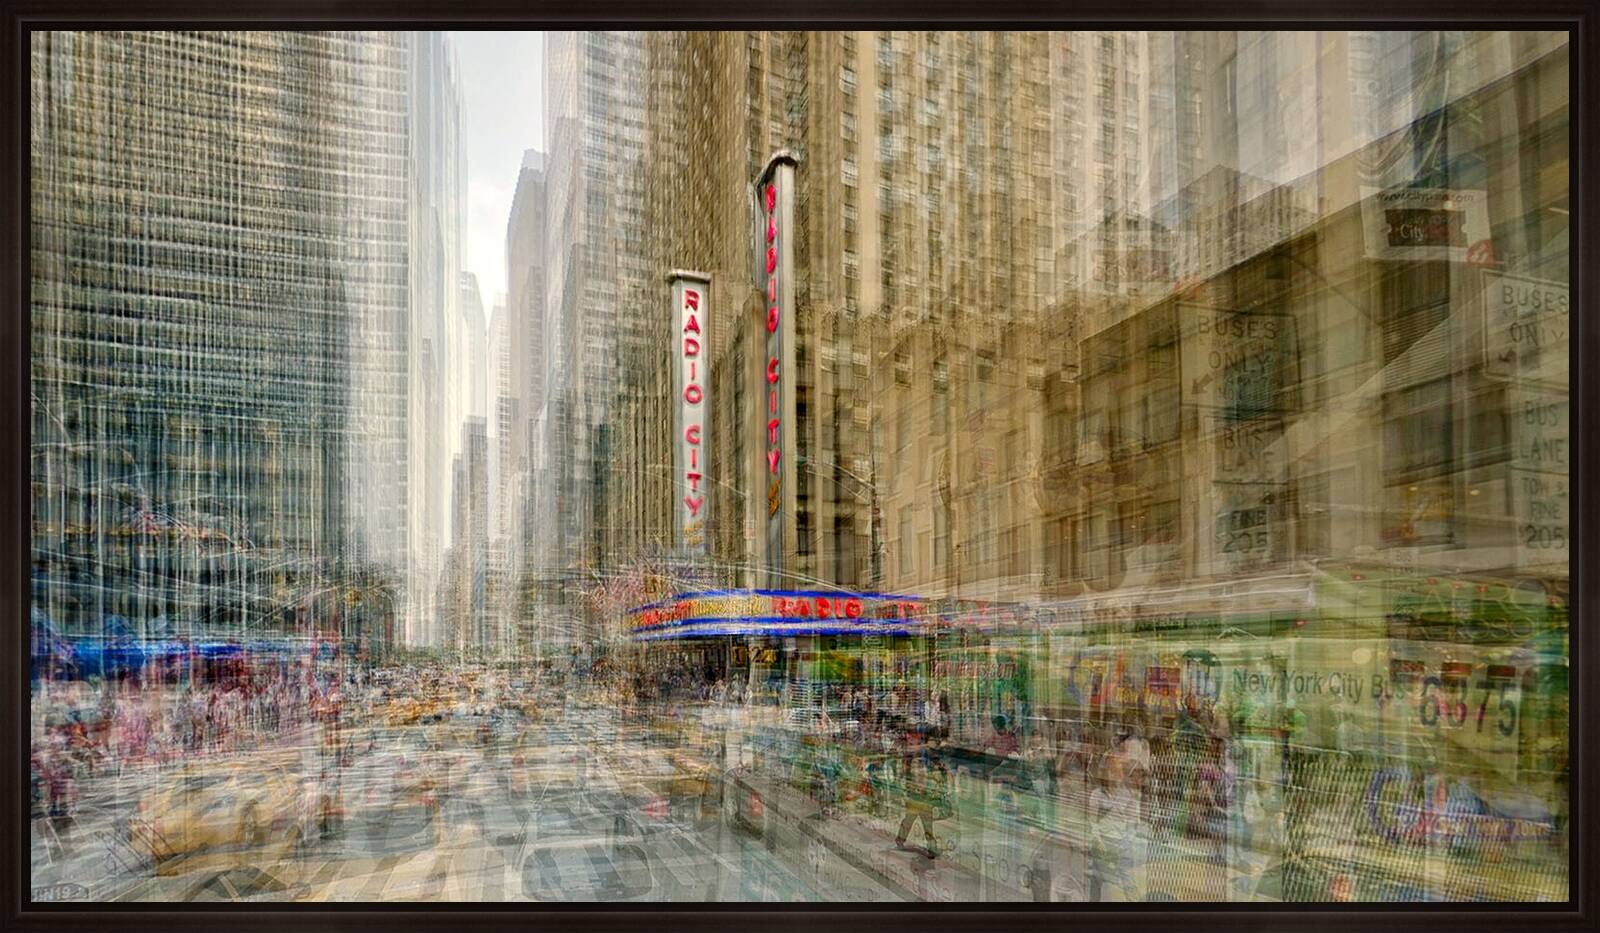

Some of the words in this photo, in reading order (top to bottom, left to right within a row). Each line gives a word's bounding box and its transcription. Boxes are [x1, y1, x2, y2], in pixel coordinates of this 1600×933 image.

[1502, 285, 1568, 316] BUSES
[1198, 315, 1279, 340] BUSES
[1509, 322, 1565, 347] ONLY
[683, 289, 703, 405] RADIO
[766, 357, 780, 474] CITY
[1525, 401, 1559, 427] BUS
[1520, 436, 1565, 464] LANE
[683, 424, 703, 517] CITY
[1529, 502, 1562, 521] FINE
[773, 595, 864, 619] RADIO
[1231, 668, 1276, 697] New
[1284, 668, 1322, 696] York
[1329, 671, 1364, 705] City
